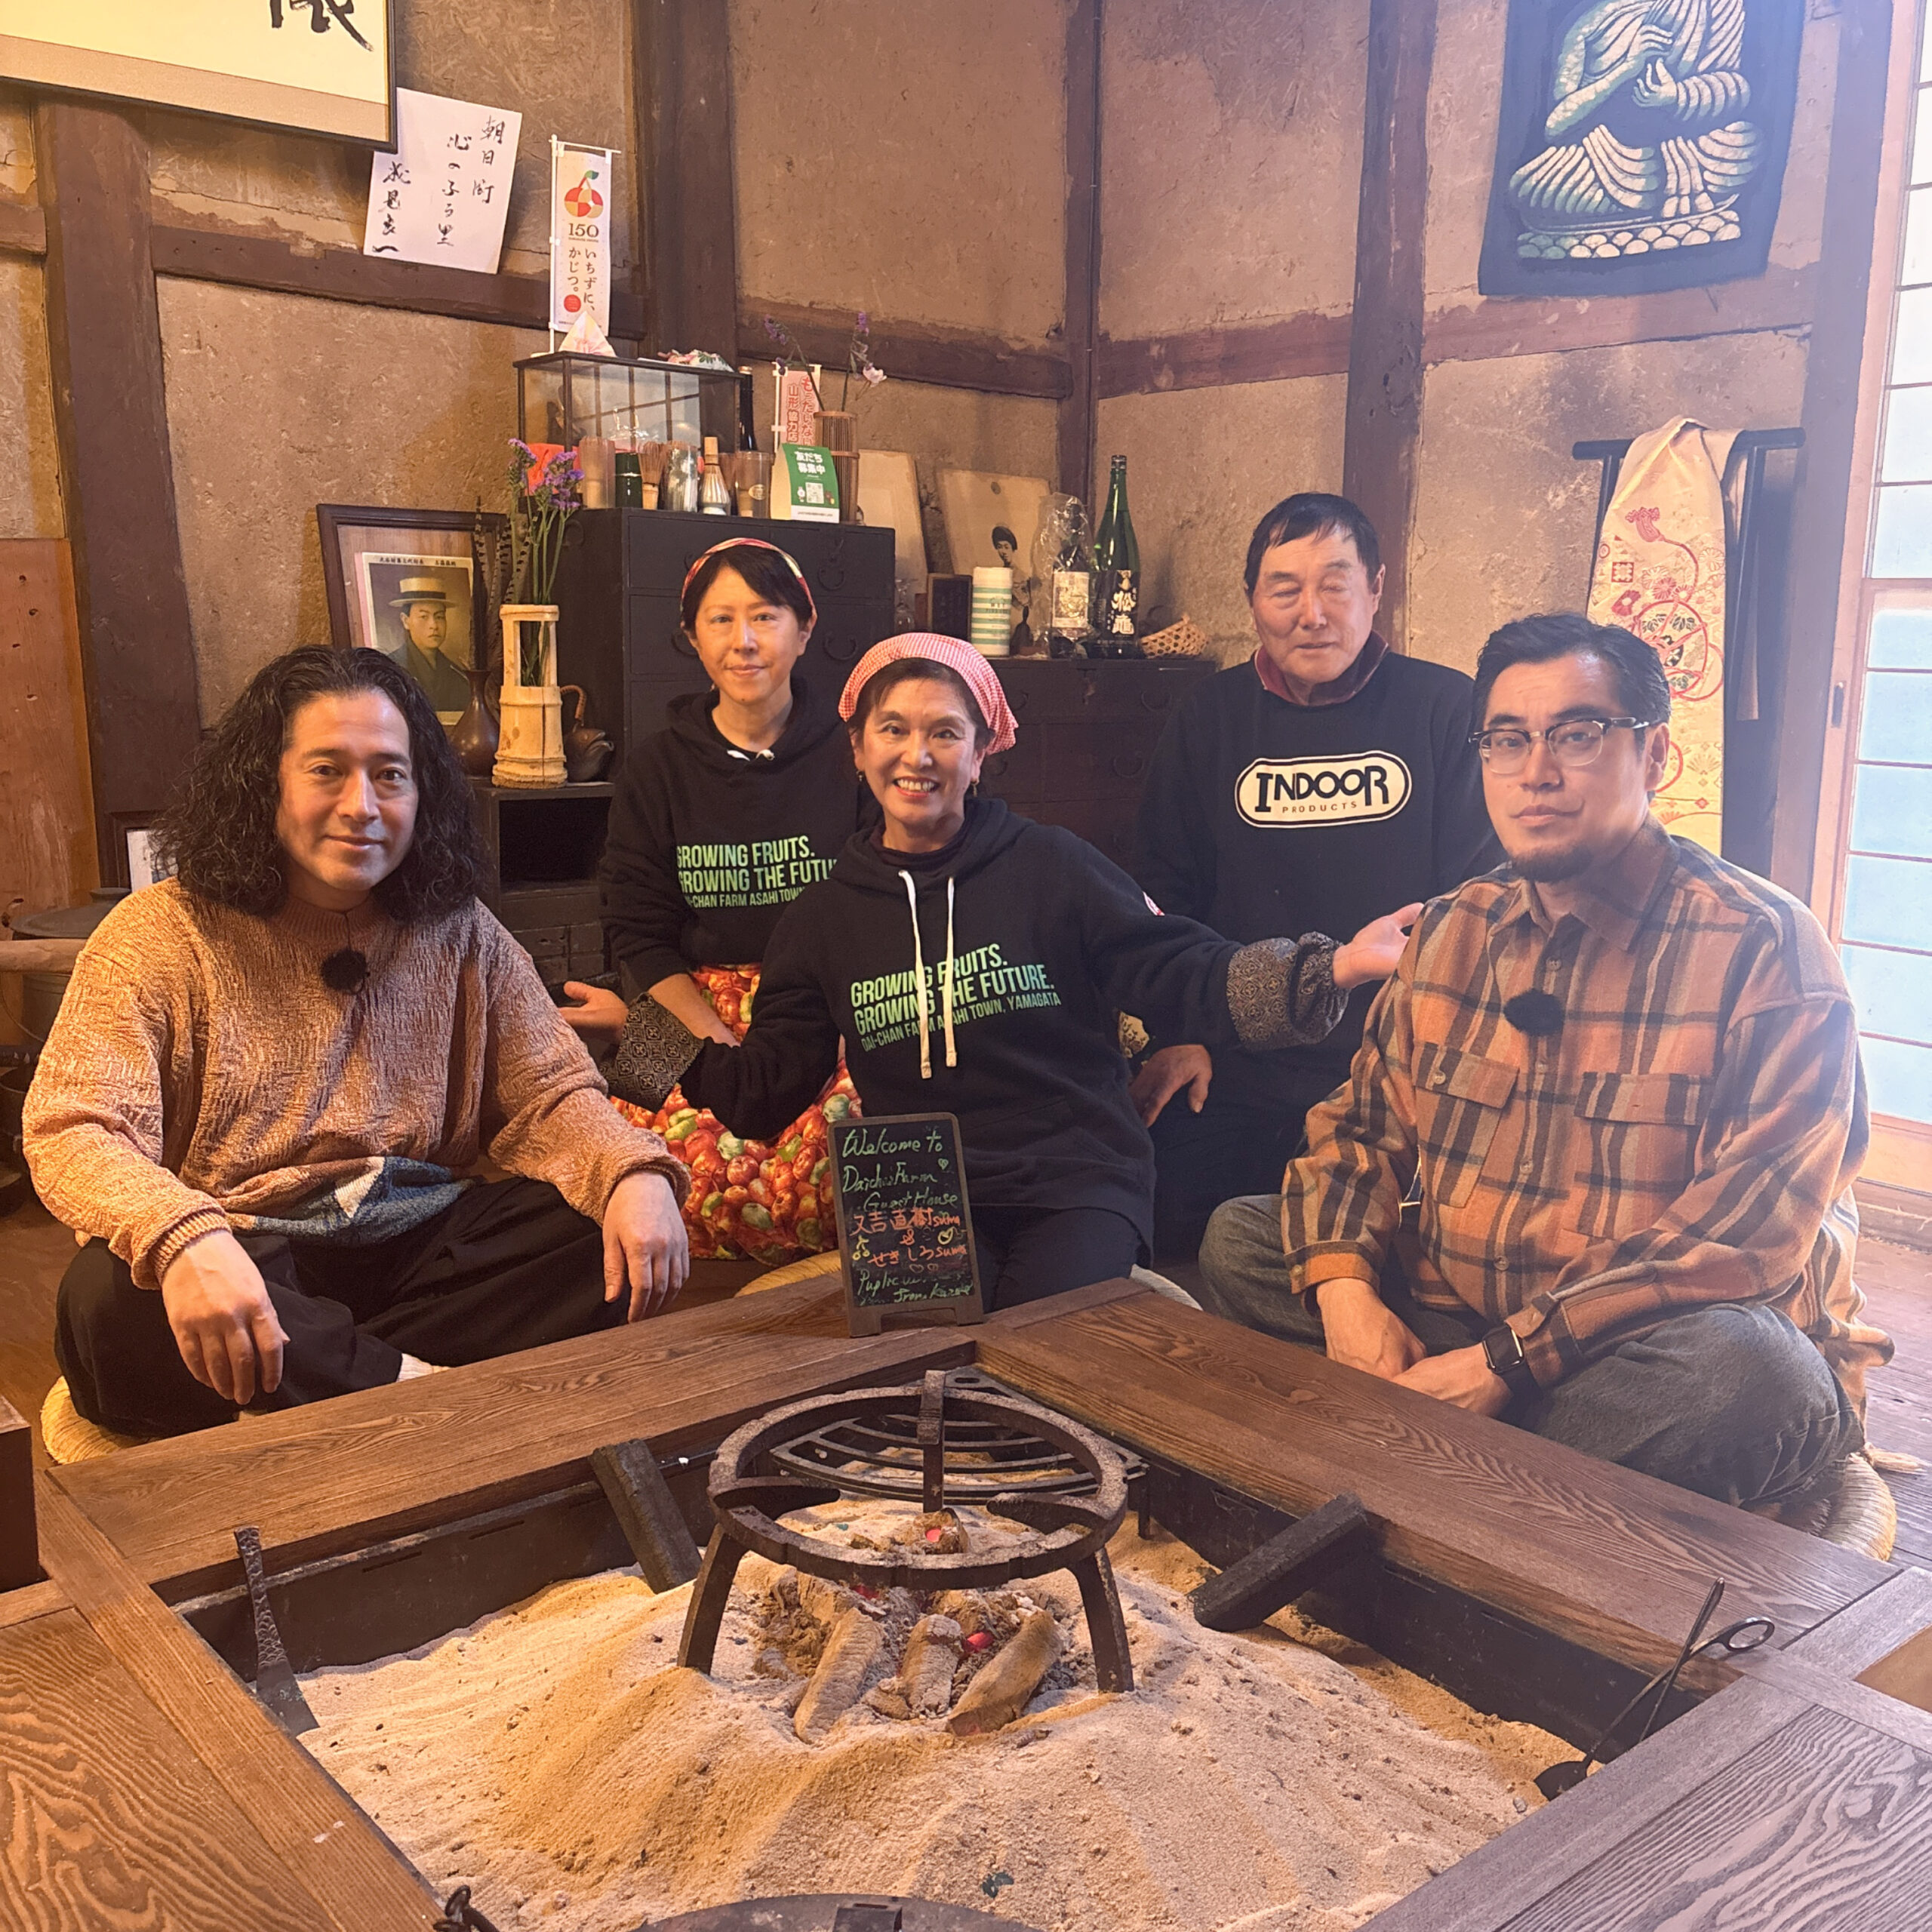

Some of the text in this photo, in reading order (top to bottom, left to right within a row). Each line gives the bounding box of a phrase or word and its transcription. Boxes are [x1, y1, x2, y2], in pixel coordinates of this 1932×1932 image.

[472, 115, 505, 204] 朝日町
[568, 223, 599, 238] 150
[568, 247, 580, 292] かじつ。
[583, 248, 597, 311] いちずに、
[1255, 765, 1389, 813] INDOOR
[1283, 801, 1357, 814] PRODUCTS
[752, 835, 815, 866] FRUITS.
[753, 864, 786, 890] THE
[789, 859, 838, 885] FUTU
[719, 894, 747, 907] FARM
[749, 890, 778, 906] ASAHI
[980, 964, 1054, 998] FUTURE.
[861, 1025, 904, 1052] DAI-CHAN
[969, 998, 1006, 1020] TOWN,
[1008, 992, 1062, 1011] YAMAGATA
[842, 1128, 921, 1158] Welcome
